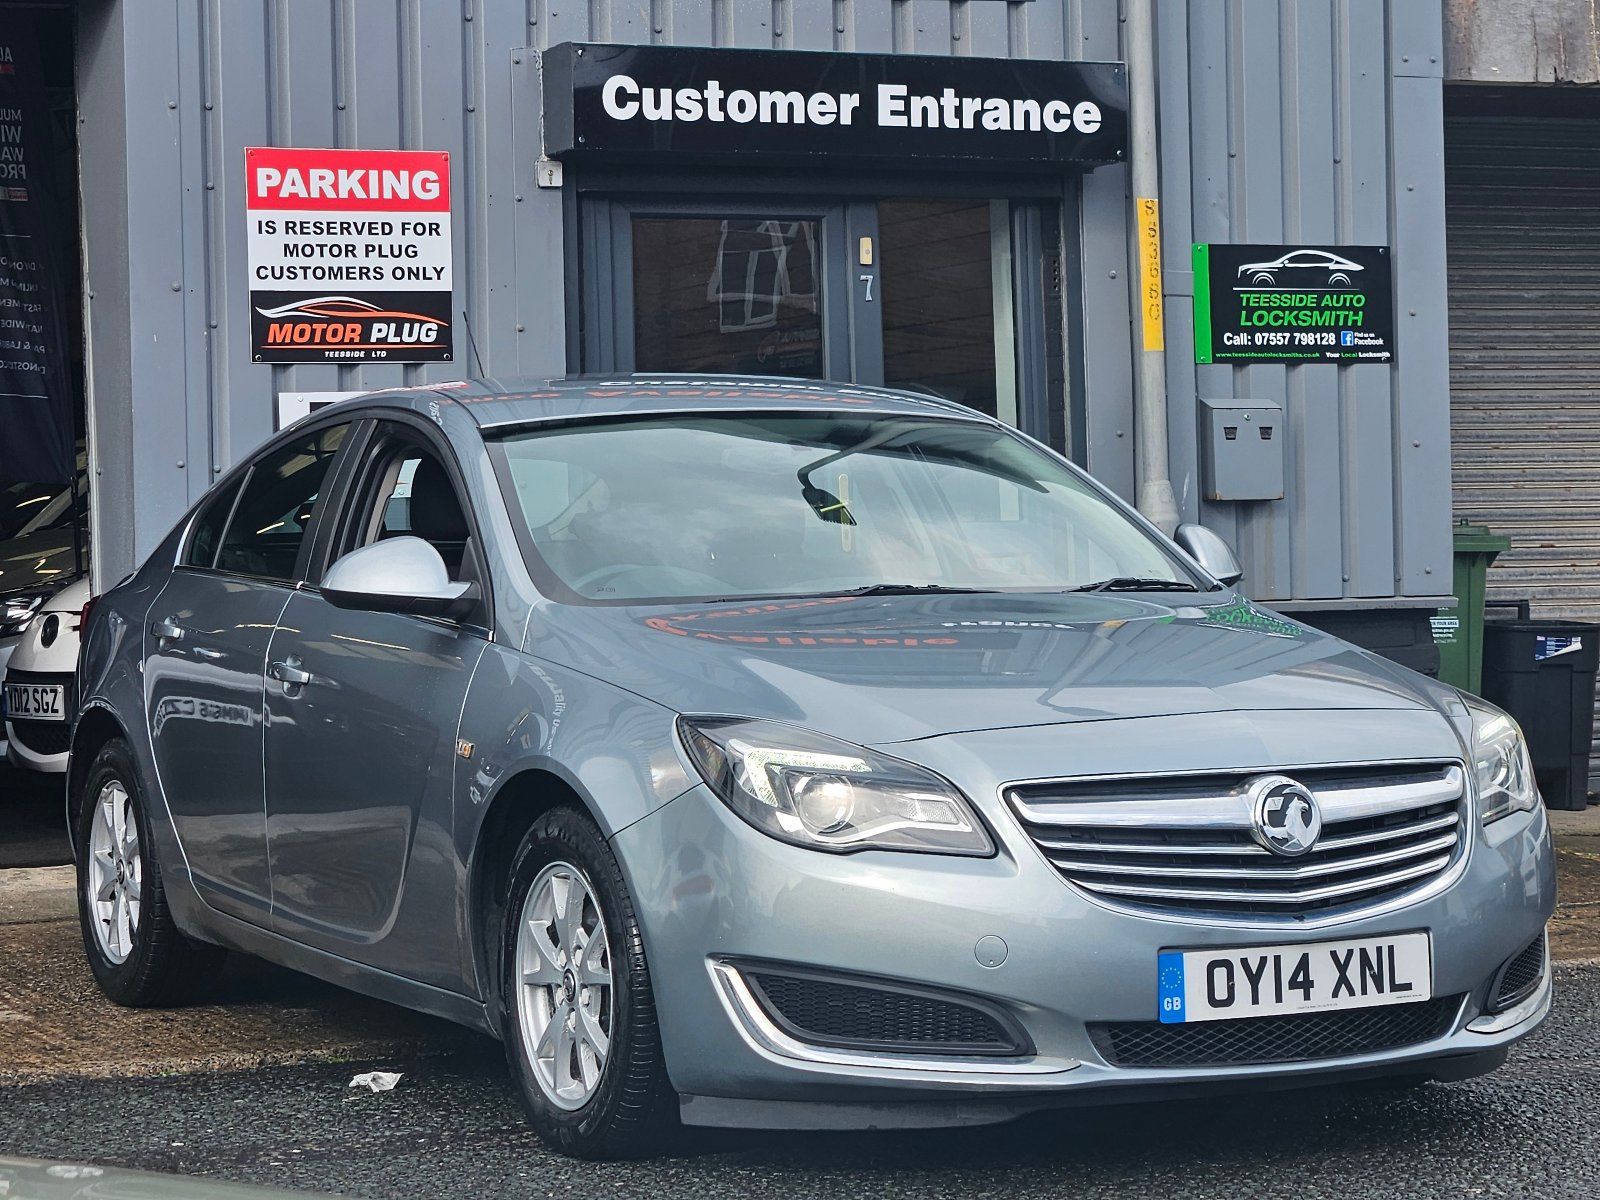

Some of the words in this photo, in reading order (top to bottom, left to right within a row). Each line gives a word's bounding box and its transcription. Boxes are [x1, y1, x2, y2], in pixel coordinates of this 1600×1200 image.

[601, 74, 860, 126] Customer
[877, 82, 1102, 135] Entrance
[256, 167, 440, 200] PARKING
[257, 220, 277, 235] IS
[284, 220, 394, 236] RESERVED
[401, 221, 442, 237] FOR
[283, 243, 358, 258] MOTOR
[364, 244, 419, 259] PLUG
[256, 265, 385, 281] CUSTOMERS
[391, 266, 446, 281] ONLY
[860, 274, 874, 302] 7
[1240, 294, 1317, 307] TEESSIDE
[1321, 294, 1366, 307] AUTO
[1240, 310, 1364, 327] LOCKSMITH
[267, 323, 363, 343] MOTOR
[370, 322, 438, 343] PLUG
[1223, 332, 1252, 346] Call:
[1255, 332, 1290, 346] 07557
[1294, 332, 1336, 346] 798128
[1354, 337, 1384, 345] Facebook
[8, 686, 30, 713] YD12
[33, 687, 59, 714] SGZ
[1206, 952, 1314, 1009] OY14
[1329, 944, 1413, 1000] XNL
[1163, 996, 1181, 1012] GB
